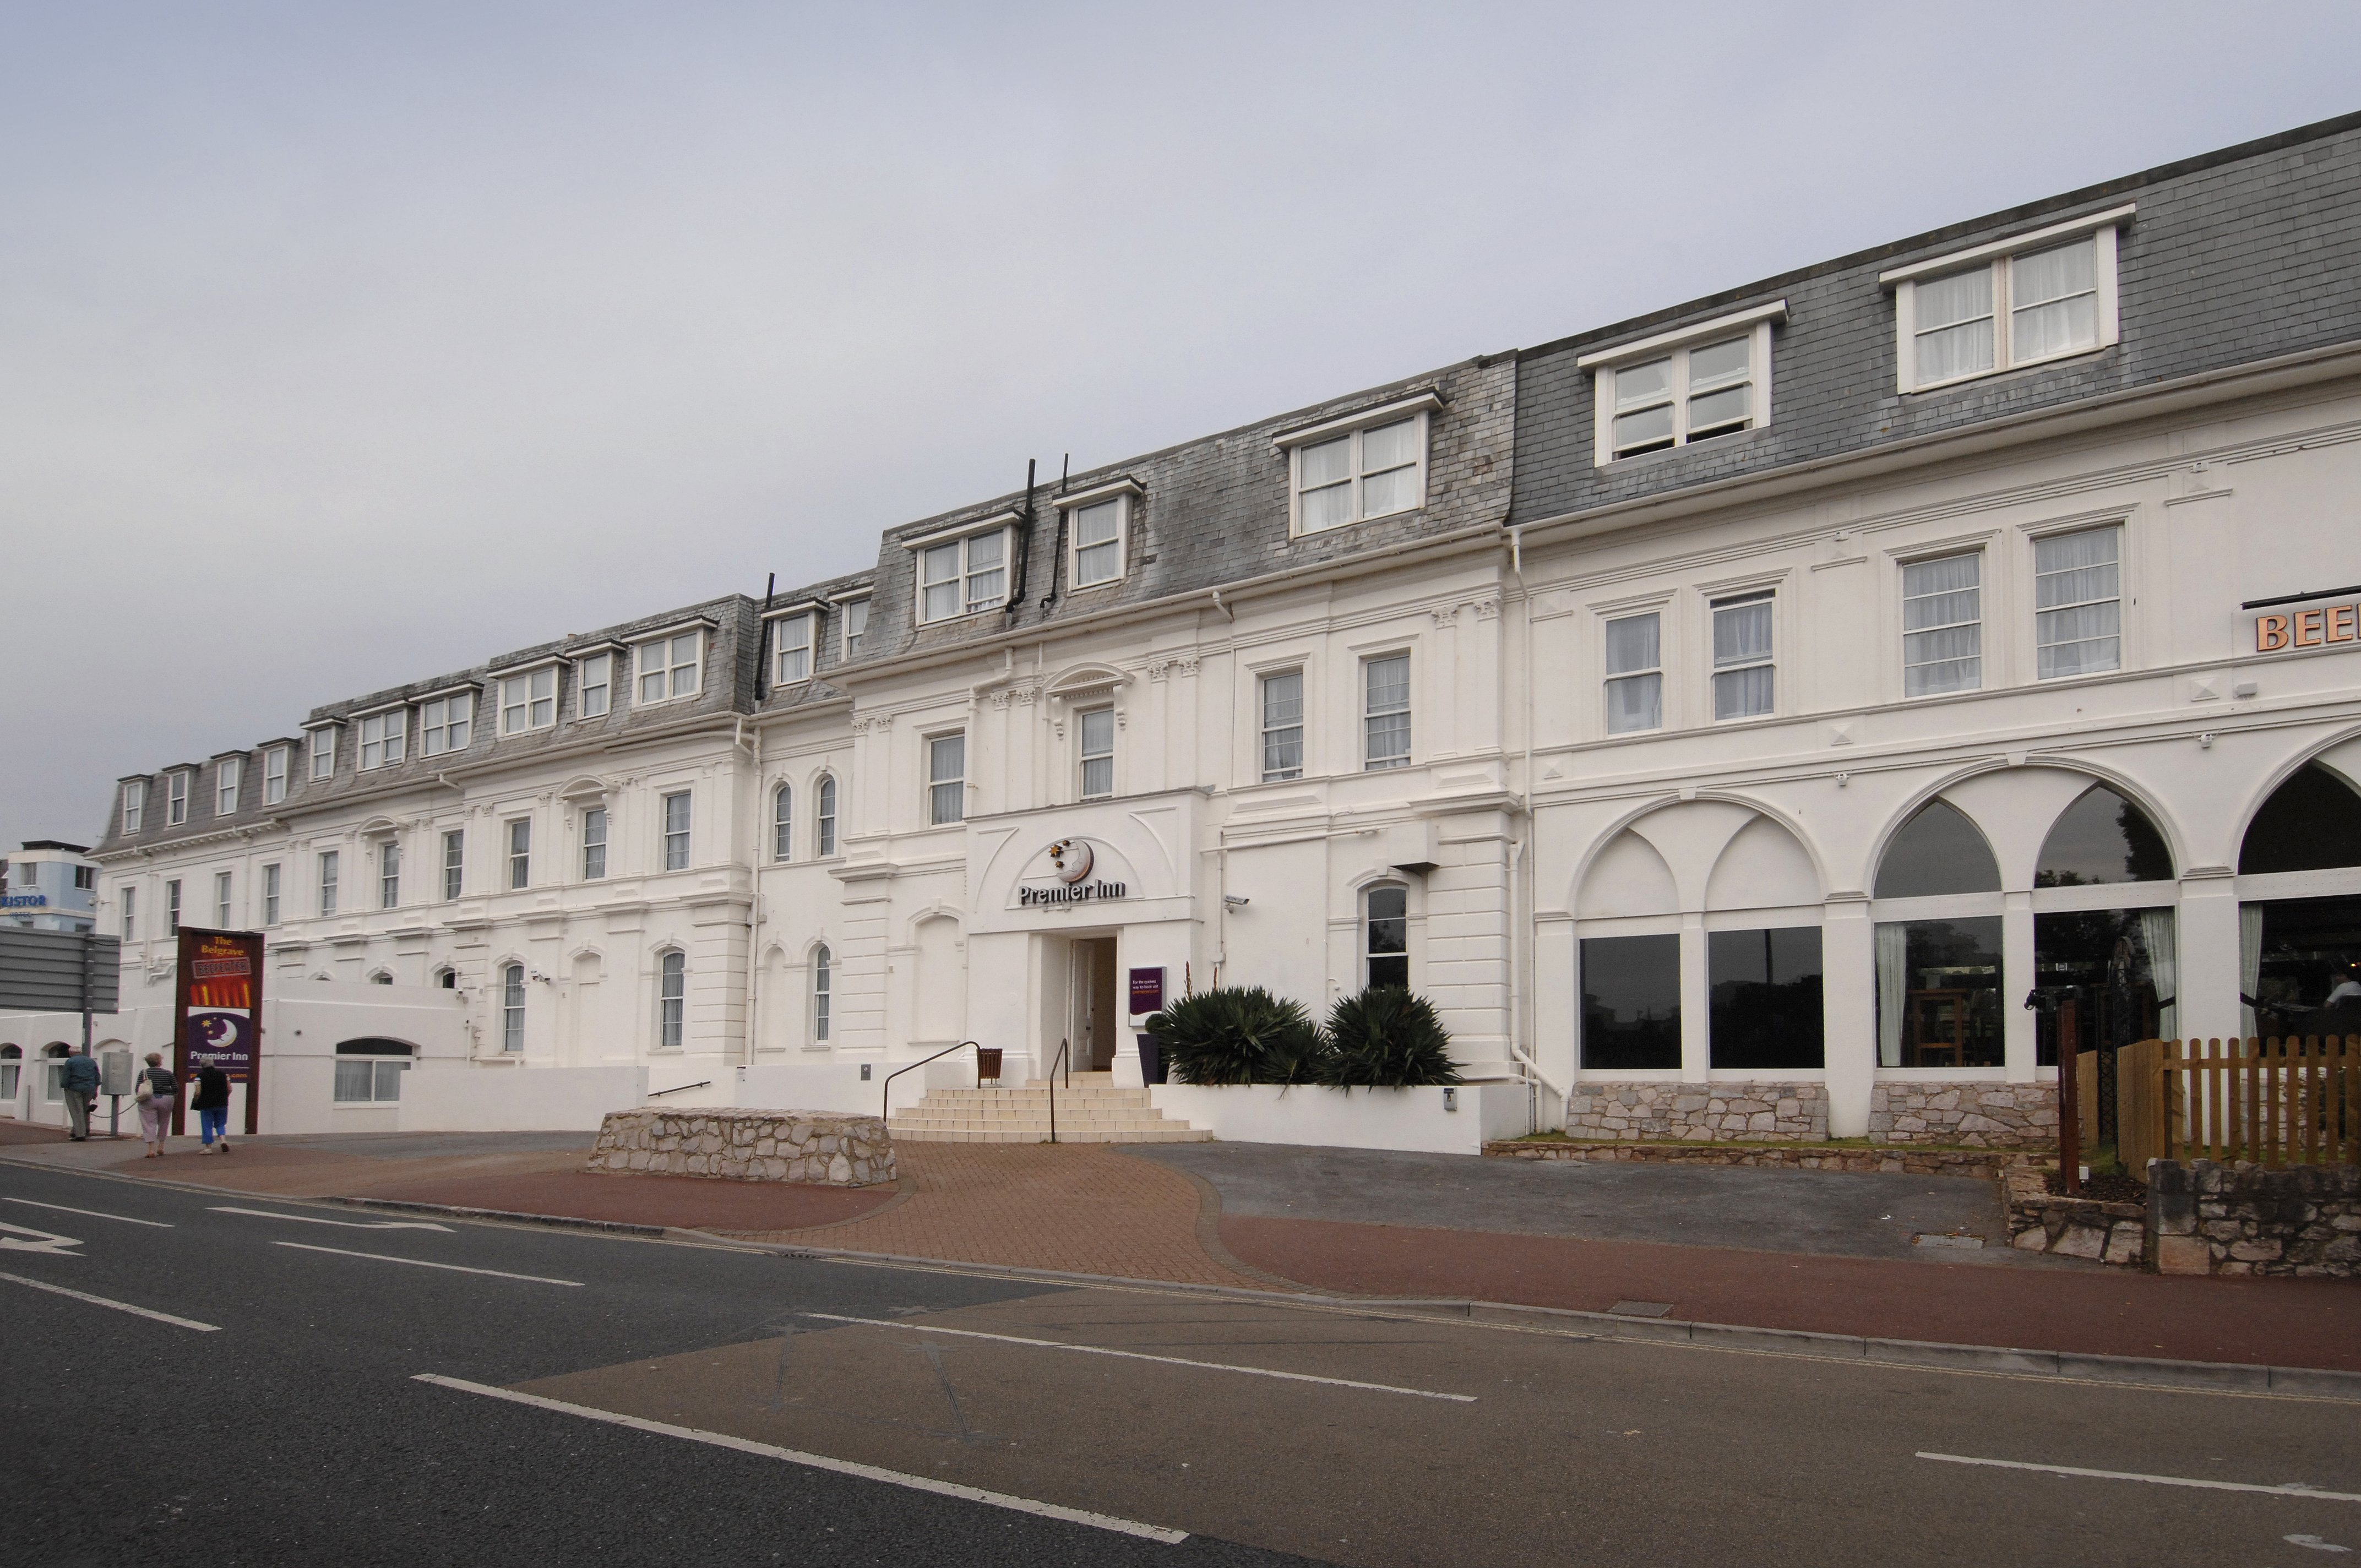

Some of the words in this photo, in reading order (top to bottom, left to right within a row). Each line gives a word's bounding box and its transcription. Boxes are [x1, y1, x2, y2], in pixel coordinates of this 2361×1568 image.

[2256, 602, 2361, 652] BEE
[1019, 882, 1092, 906] Premier
[1094, 879, 1126, 899] Inn
[214, 936, 232, 945] The
[201, 945, 244, 957] Belgrave
[232, 1052, 248, 1060] Inn
